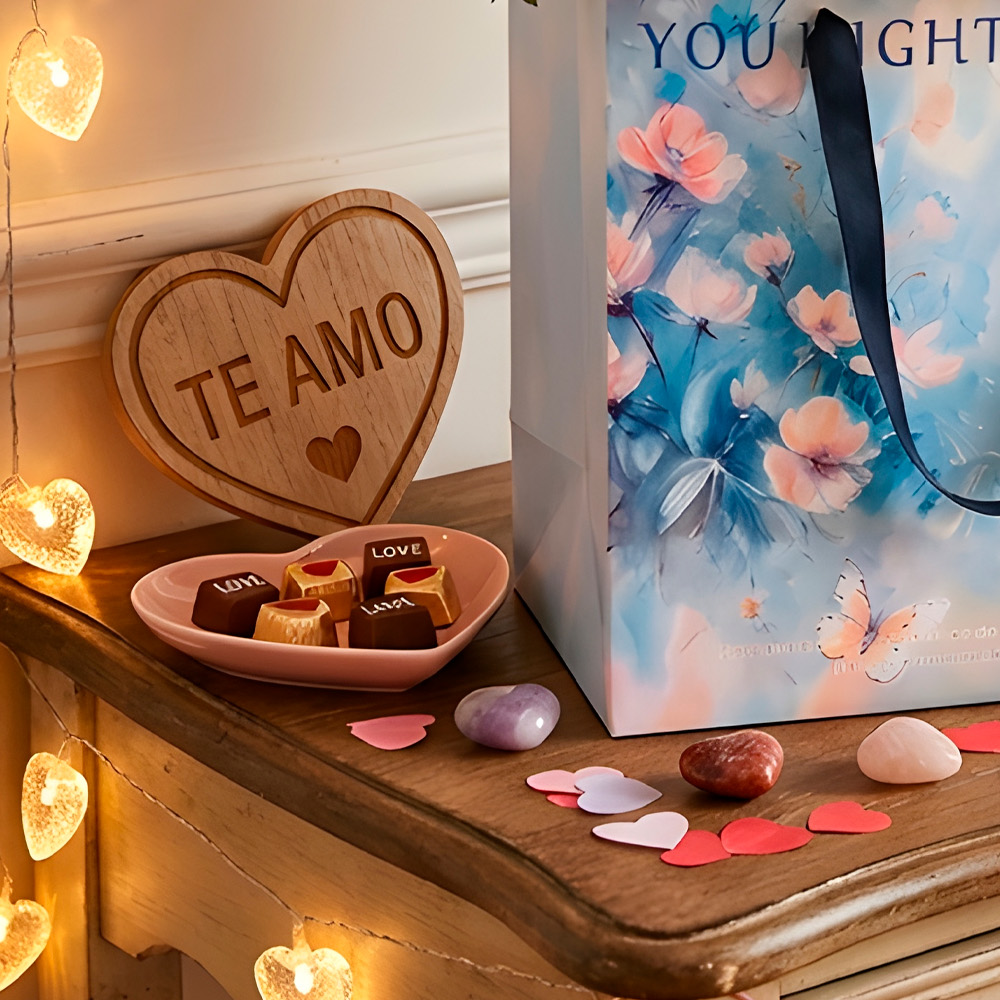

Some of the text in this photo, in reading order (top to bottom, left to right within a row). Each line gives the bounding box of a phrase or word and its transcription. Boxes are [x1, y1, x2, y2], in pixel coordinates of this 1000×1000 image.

[175, 291, 423, 442] TE AMO
[371, 542, 423, 559] LOVE
